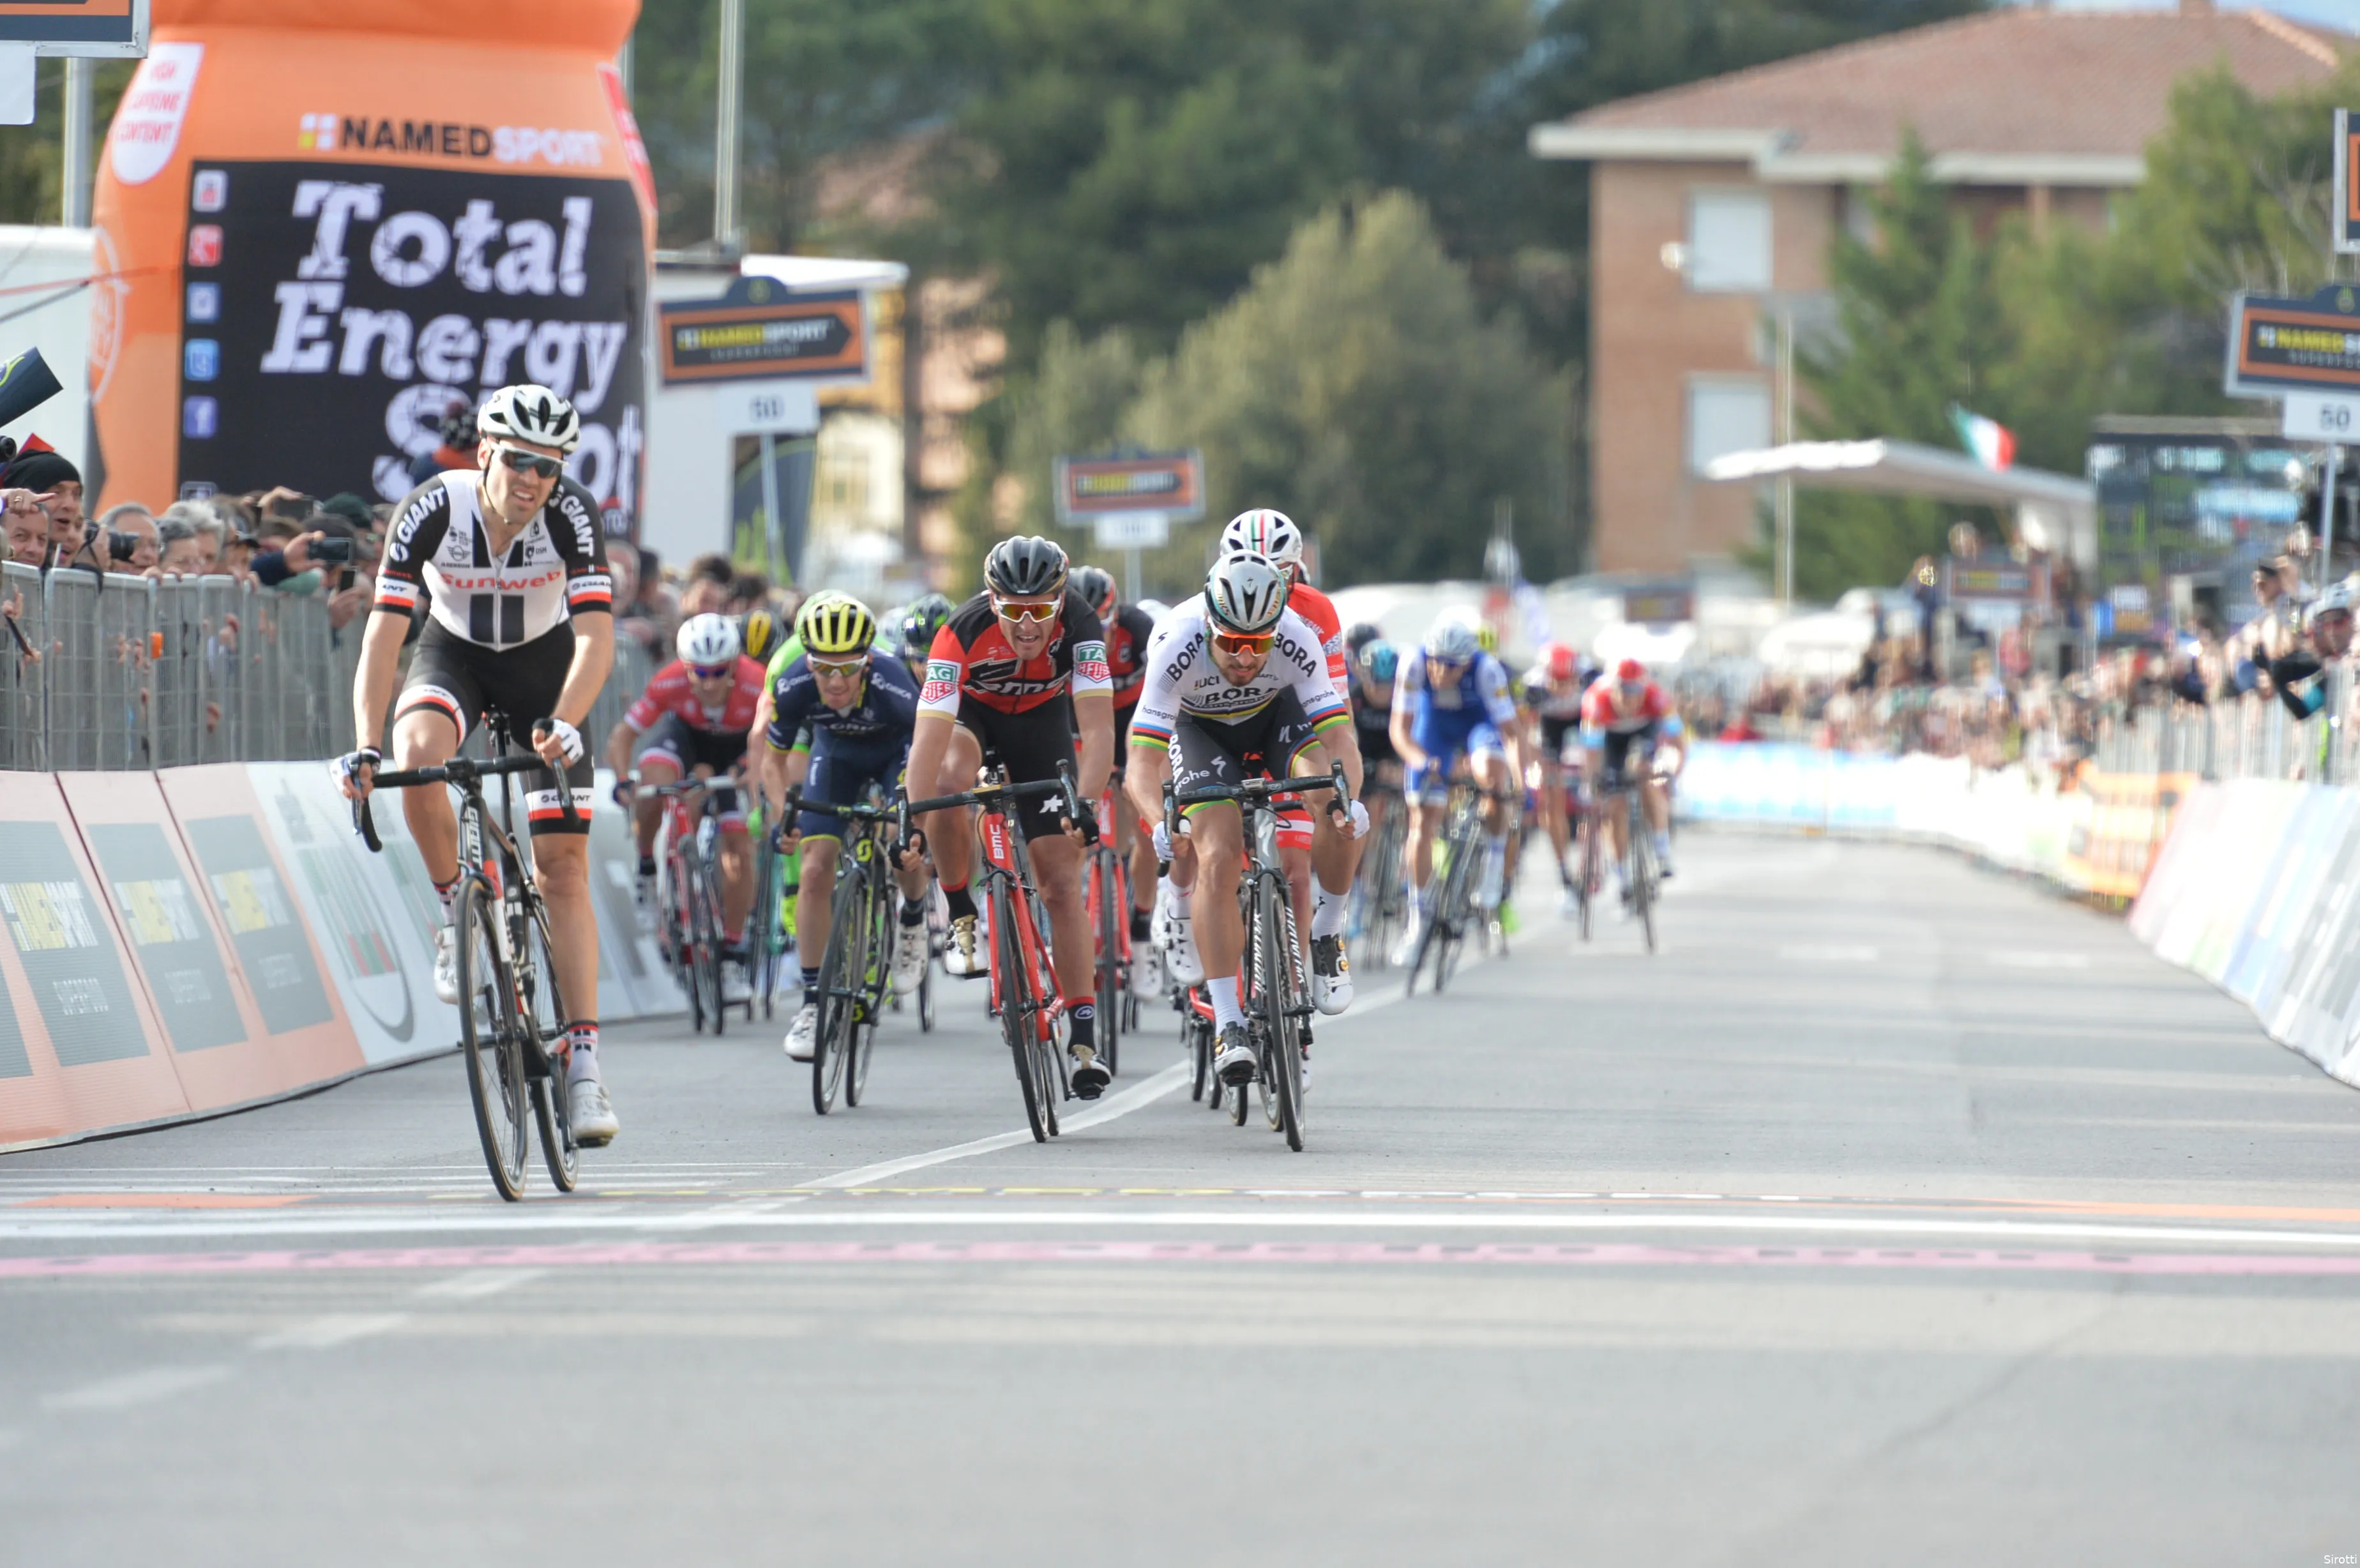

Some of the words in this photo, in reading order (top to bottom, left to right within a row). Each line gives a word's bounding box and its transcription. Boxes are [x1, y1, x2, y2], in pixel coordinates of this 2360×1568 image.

[339, 115, 603, 167] NAMEDSPORT
[292, 179, 594, 297] Total
[259, 282, 626, 414] Energy
[2276, 327, 2360, 354] NAMEDS
[2320, 404, 2350, 432] 50
[372, 383, 642, 508] Sot
[397, 486, 446, 543] GIANT
[561, 495, 594, 557] GIANT
[1083, 647, 1107, 660] TA
[1166, 632, 1204, 682] BORA
[1274, 632, 1317, 677] BORA
[1199, 675, 1220, 688] UCI
[1302, 690, 1335, 708] ansgrohe
[990, 824, 1005, 859] BMC
